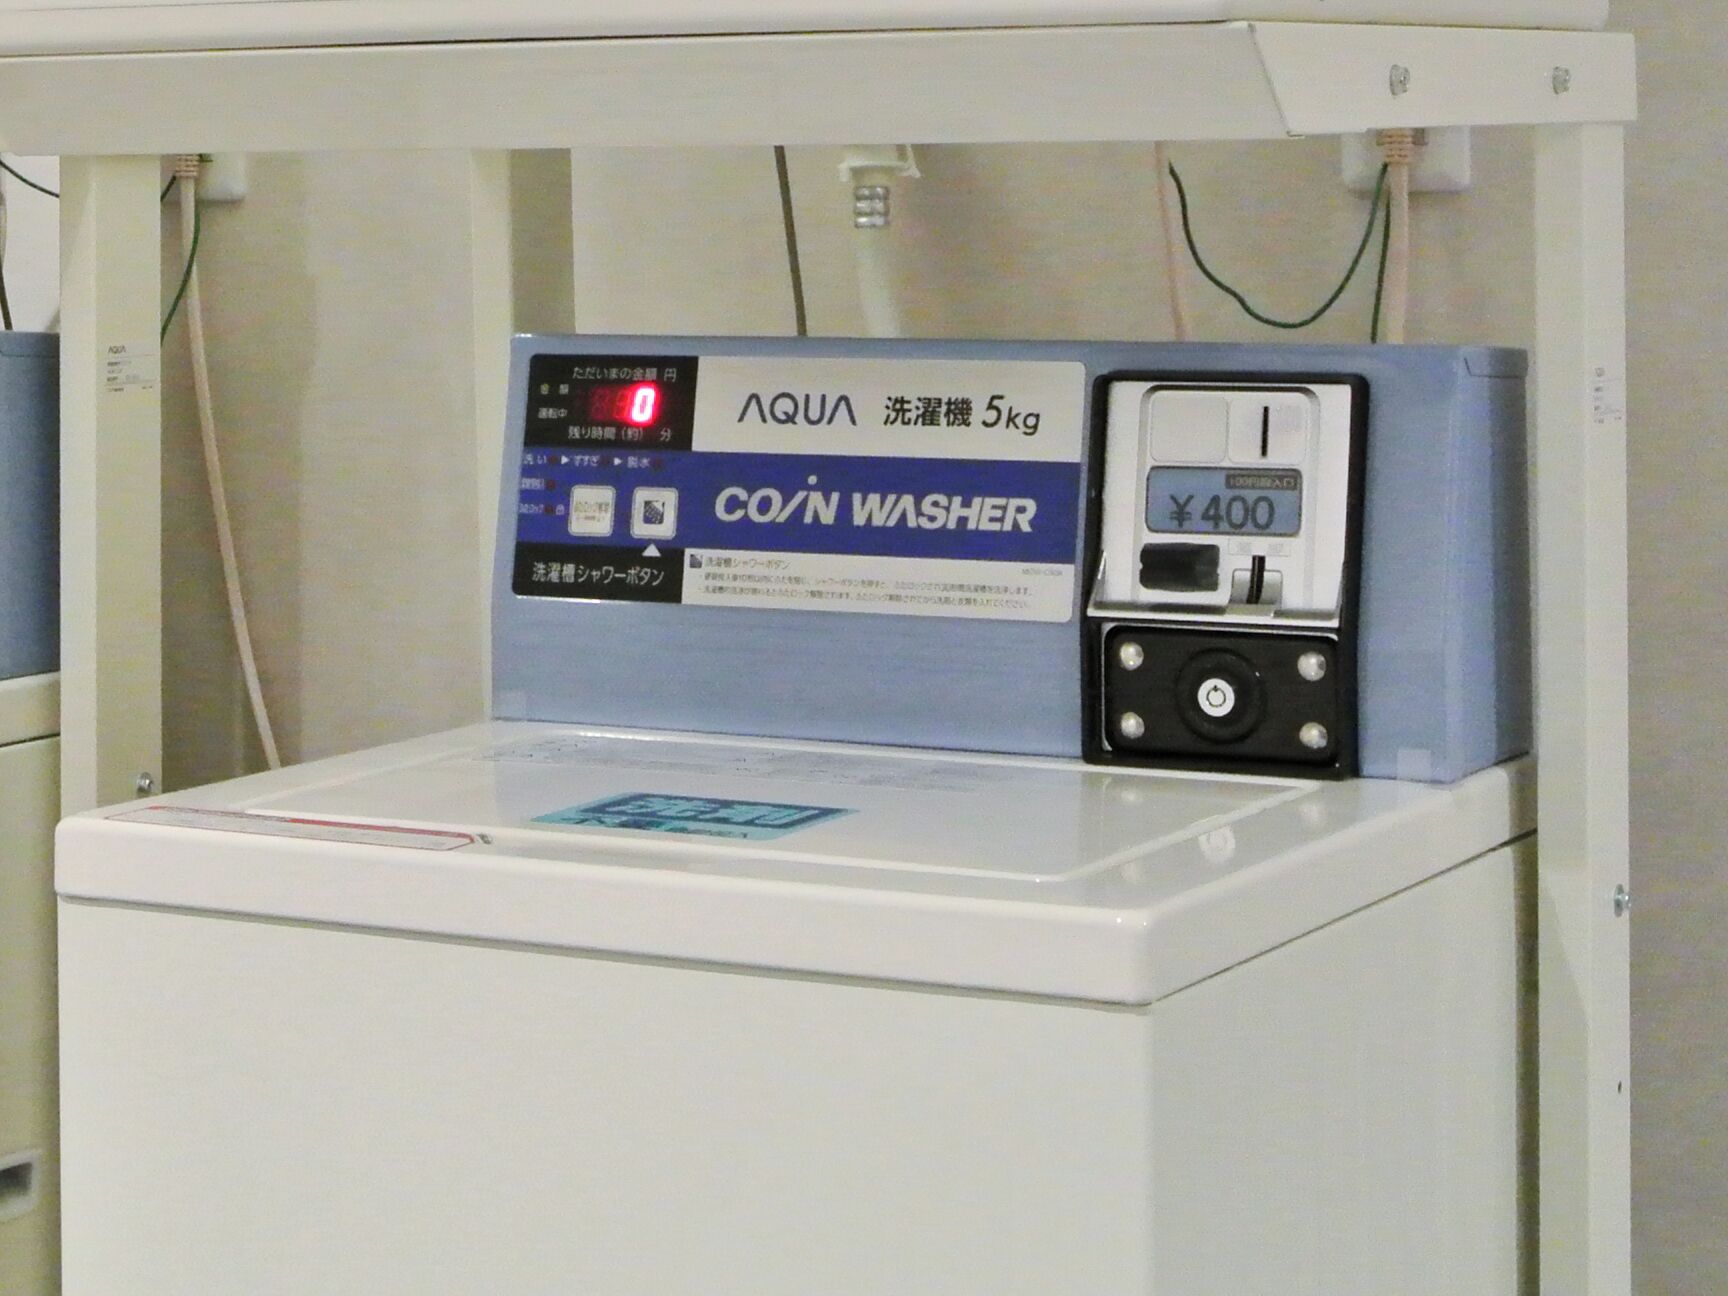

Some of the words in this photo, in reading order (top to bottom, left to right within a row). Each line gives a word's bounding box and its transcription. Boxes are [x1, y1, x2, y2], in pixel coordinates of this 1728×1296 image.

[664, 368, 677, 382] 円
[631, 387, 656, 423] 0
[737, 392, 857, 426] AQUA
[883, 395, 972, 427] 洗濯機
[981, 395, 1041, 436] 5kg
[660, 428, 672, 441] 分
[852, 493, 1037, 534] WASHER
[1169, 494, 1276, 531] ¥400
[532, 561, 664, 586] 洗濯槽シャワーボタン
